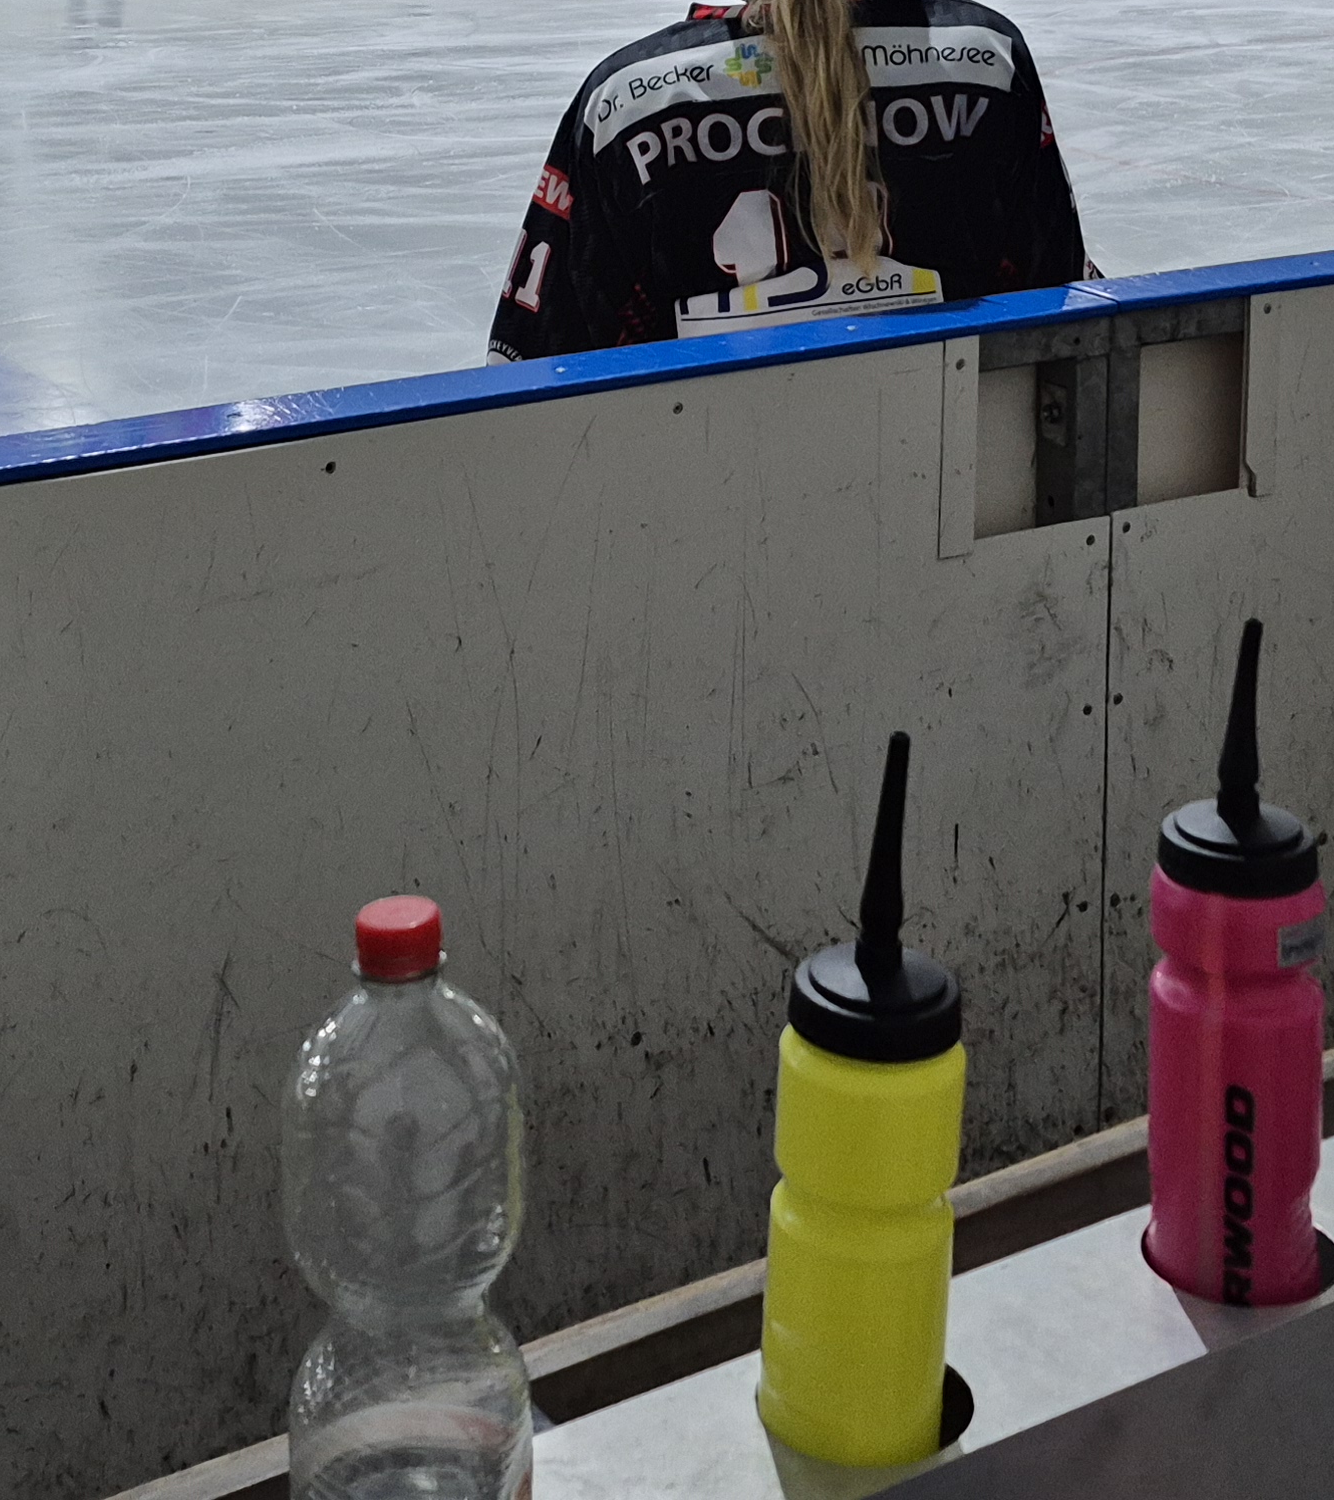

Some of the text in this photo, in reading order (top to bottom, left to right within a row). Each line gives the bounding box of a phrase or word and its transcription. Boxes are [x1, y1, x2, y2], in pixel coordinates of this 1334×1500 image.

[597, 43, 996, 124] Dr. Becker Möhnesee
[626, 92, 989, 187] PROCOW
[842, 273, 903, 296] eGbR
